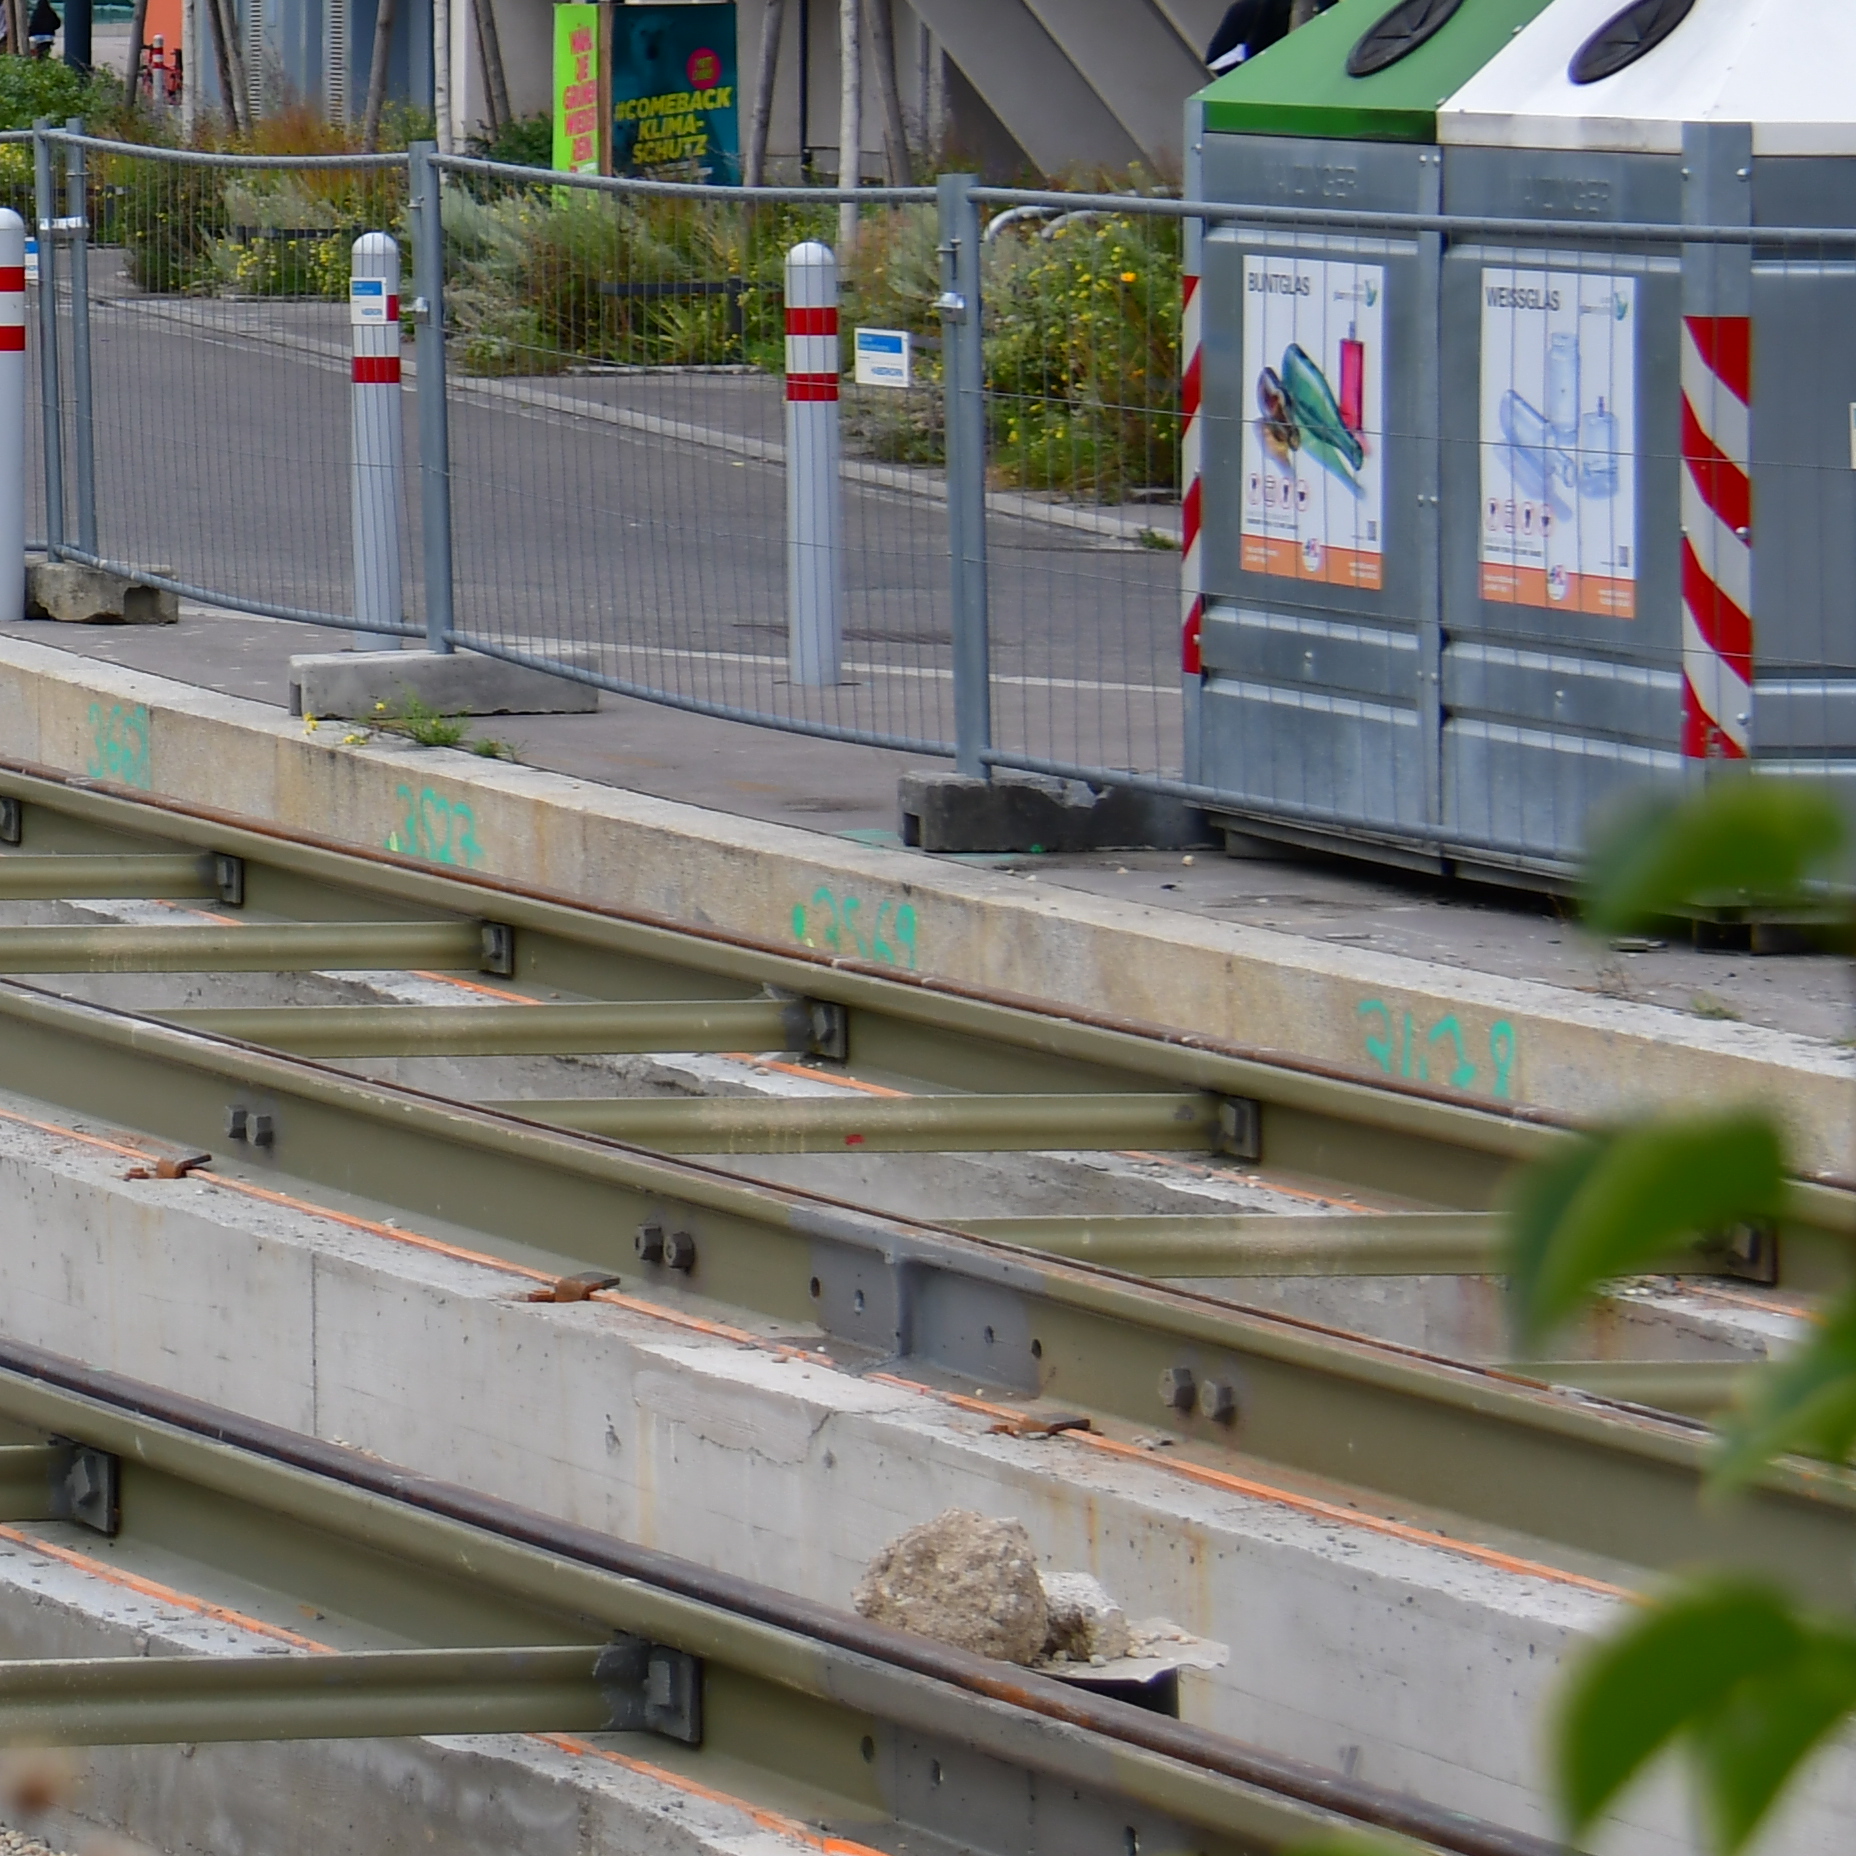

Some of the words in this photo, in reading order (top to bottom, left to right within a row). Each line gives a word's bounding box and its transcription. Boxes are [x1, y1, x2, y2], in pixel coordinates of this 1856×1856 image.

[615, 89, 732, 121] #COMEBACK
[639, 113, 704, 140] KLIMA-
[633, 134, 707, 164] SCHUTZ
[1247, 271, 1311, 297] BUNTGLAS
[1485, 285, 1561, 311] WEISSGLAS
